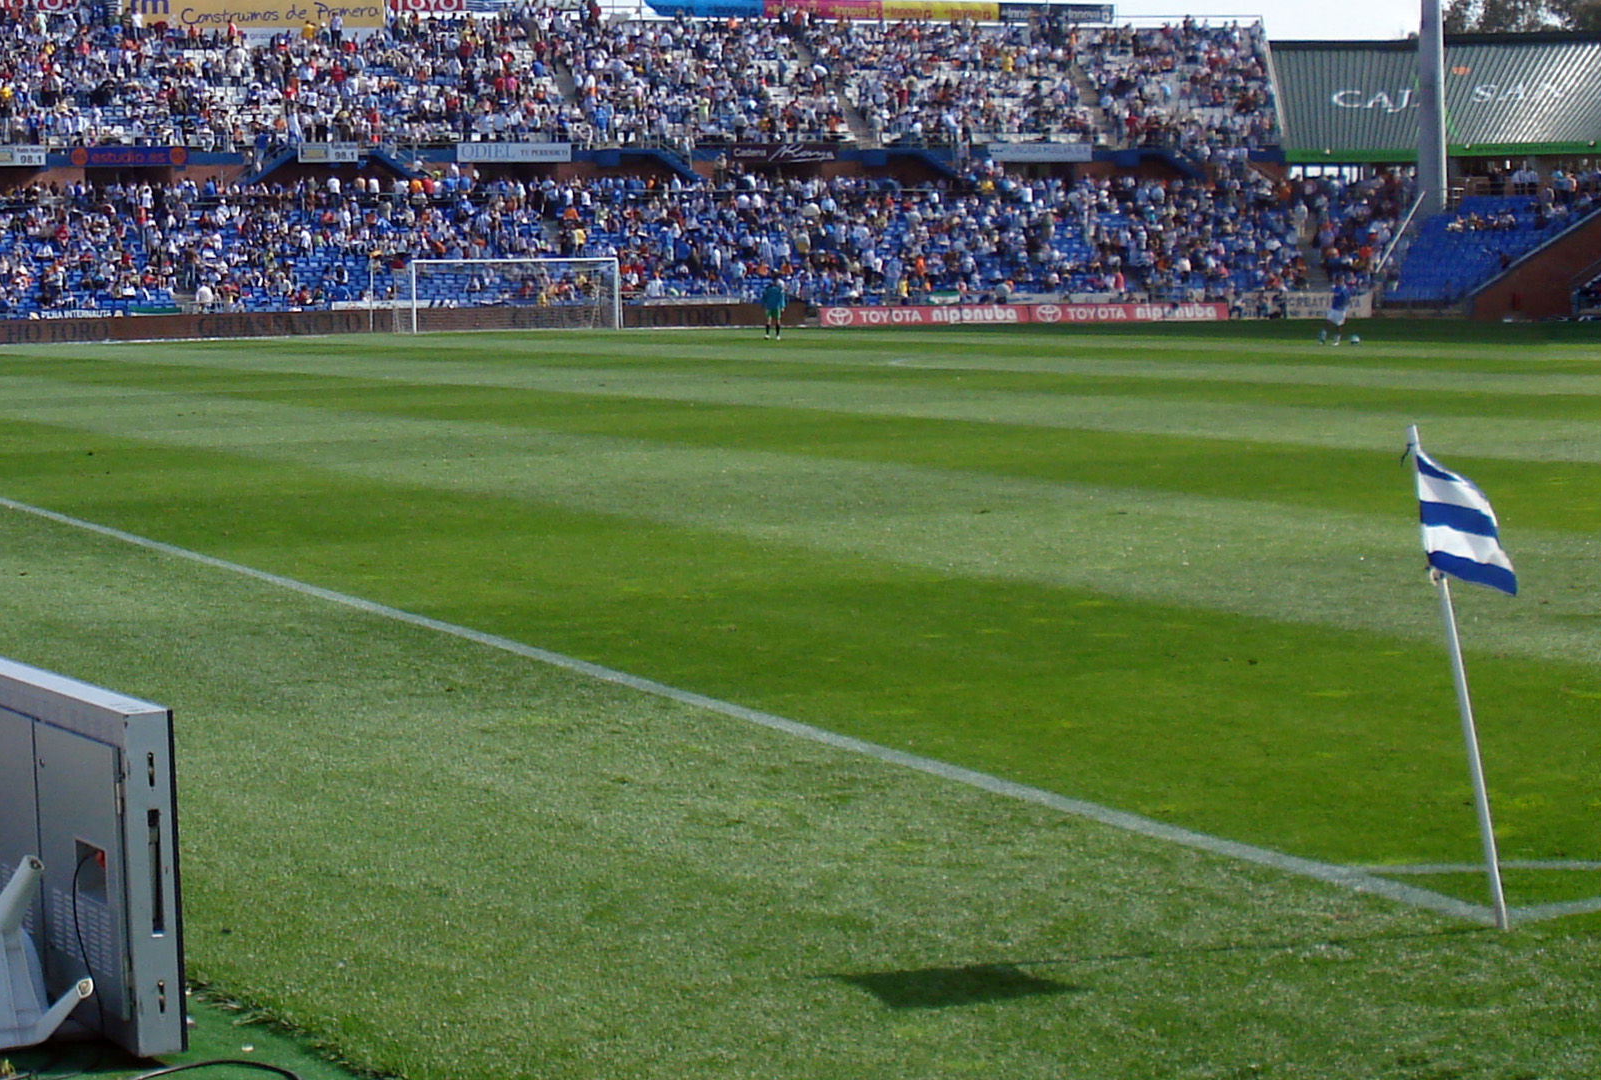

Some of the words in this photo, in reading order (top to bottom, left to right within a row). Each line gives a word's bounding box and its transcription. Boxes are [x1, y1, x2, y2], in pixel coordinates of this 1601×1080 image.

[285, 2, 307, 20] de
[334, 151, 355, 161] 98.1
[461, 143, 515, 159] ODIEL
[733, 147, 768, 158] Cadena
[20, 155, 42, 165] 98.1
[859, 308, 922, 324] TOYOTA
[931, 305, 1018, 324] niponuba
[1066, 305, 1126, 321] TOYOTA
[49, 320, 109, 342] TORO
